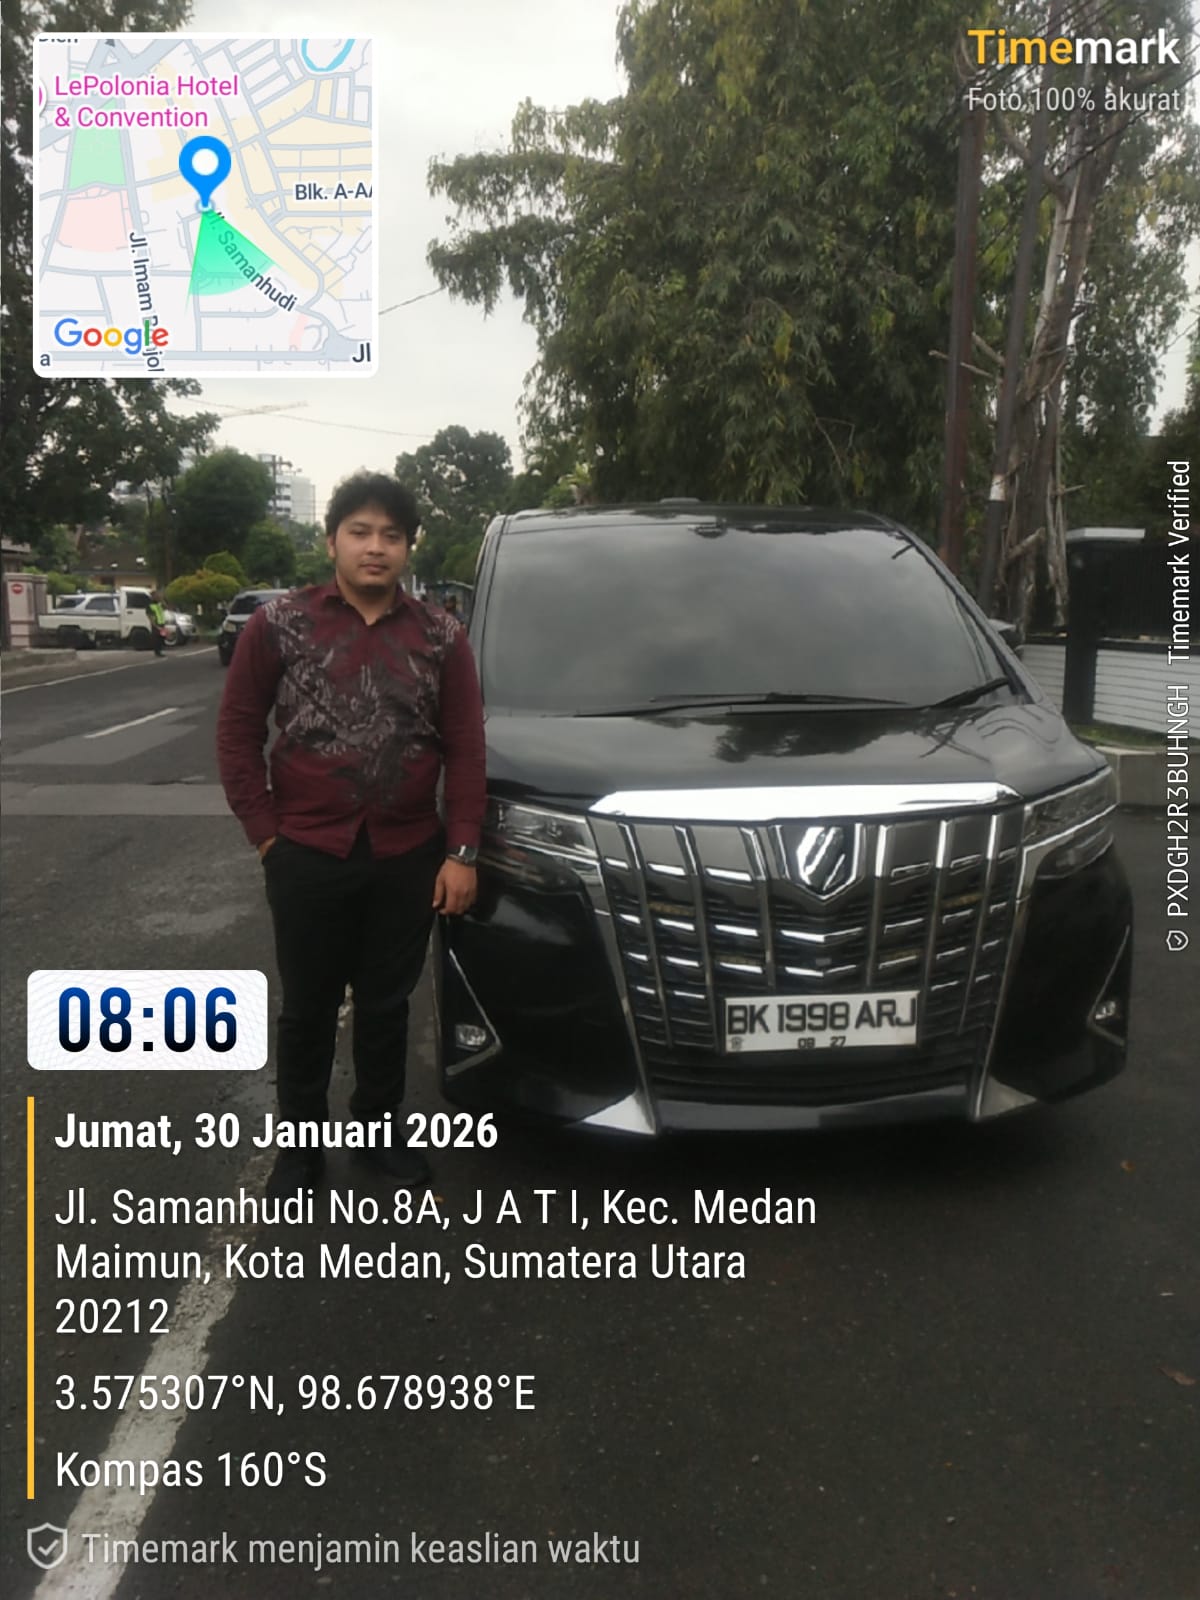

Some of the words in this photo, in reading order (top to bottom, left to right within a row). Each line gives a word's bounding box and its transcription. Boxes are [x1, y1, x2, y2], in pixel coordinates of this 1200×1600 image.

[727, 1004, 770, 1035] BK
[777, 1001, 850, 1033] 1998
[854, 998, 917, 1029] ARJ
